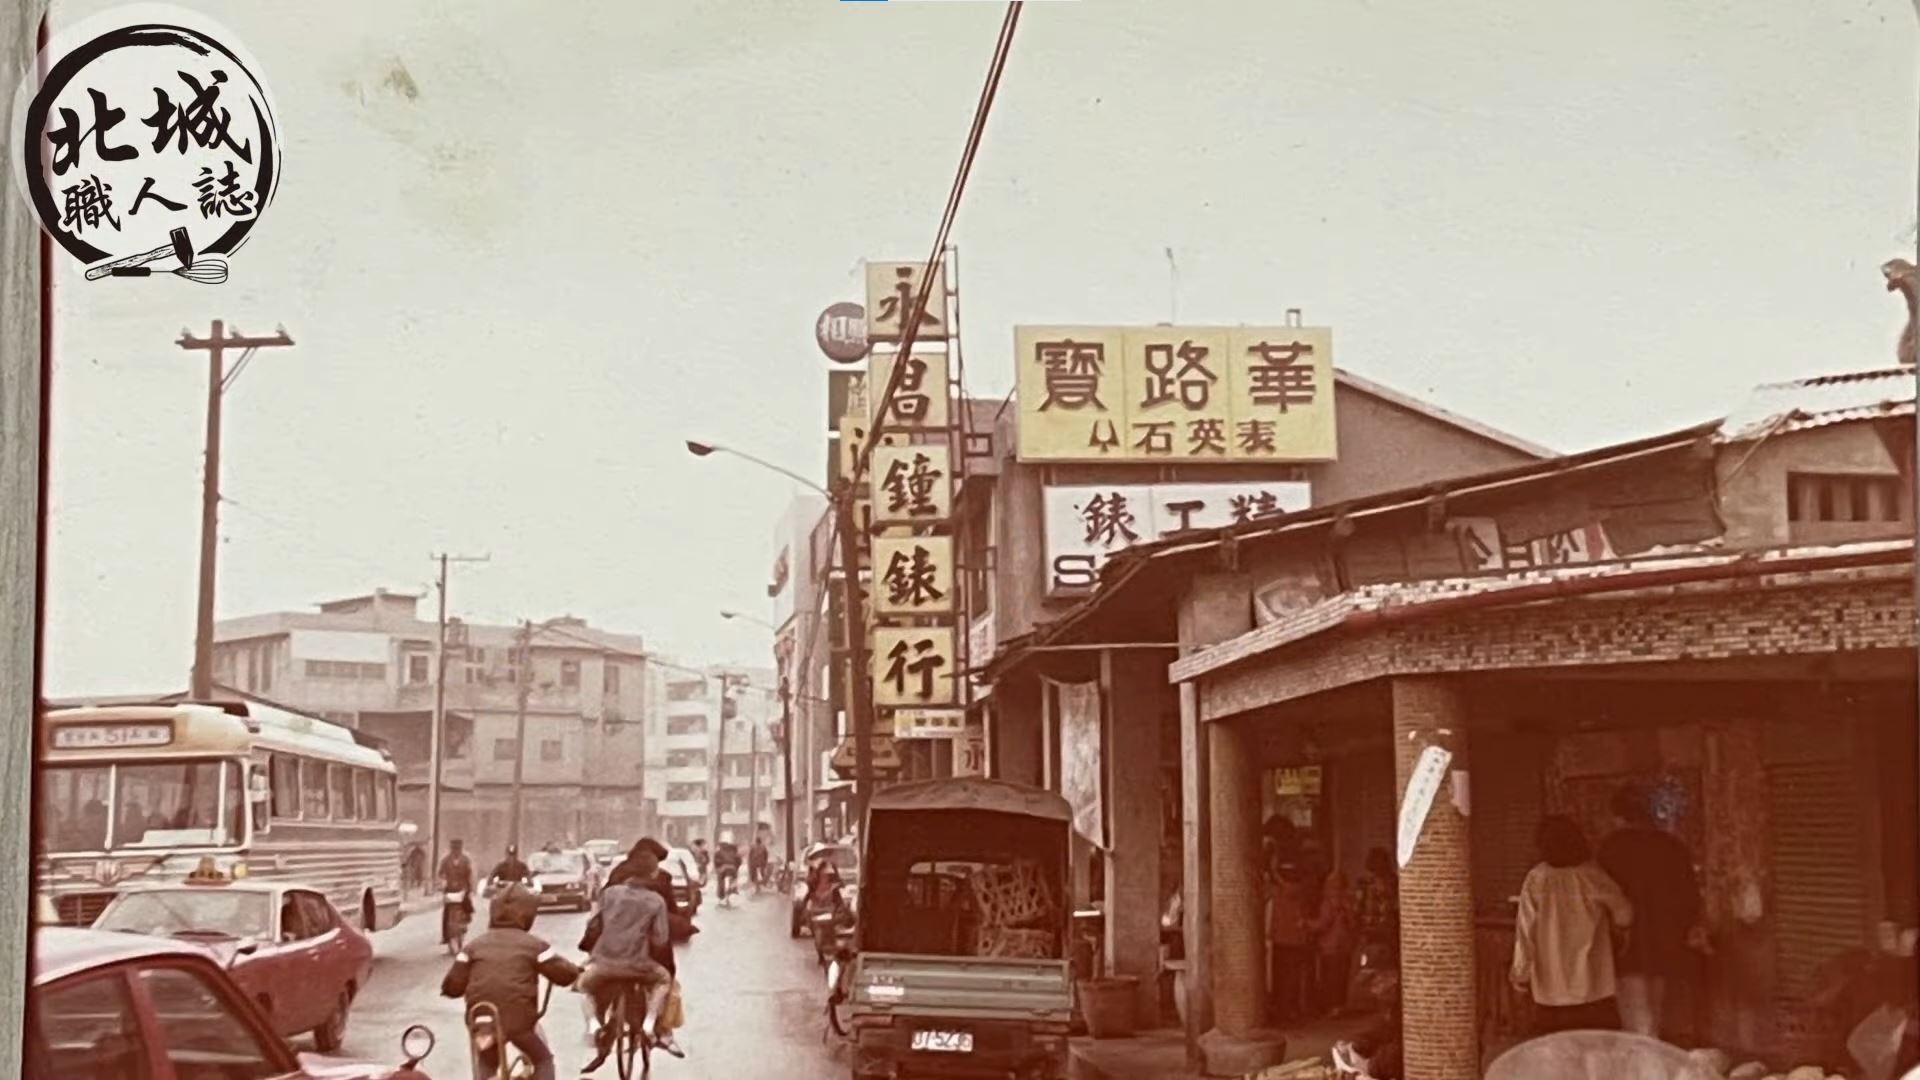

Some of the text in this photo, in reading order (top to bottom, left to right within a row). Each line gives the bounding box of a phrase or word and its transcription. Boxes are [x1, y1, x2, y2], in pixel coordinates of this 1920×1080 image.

[1035, 338, 1317, 414] 寶路華
[1132, 418, 1277, 455] 石英表
[876, 267, 946, 698] 永昌鐘錶行
